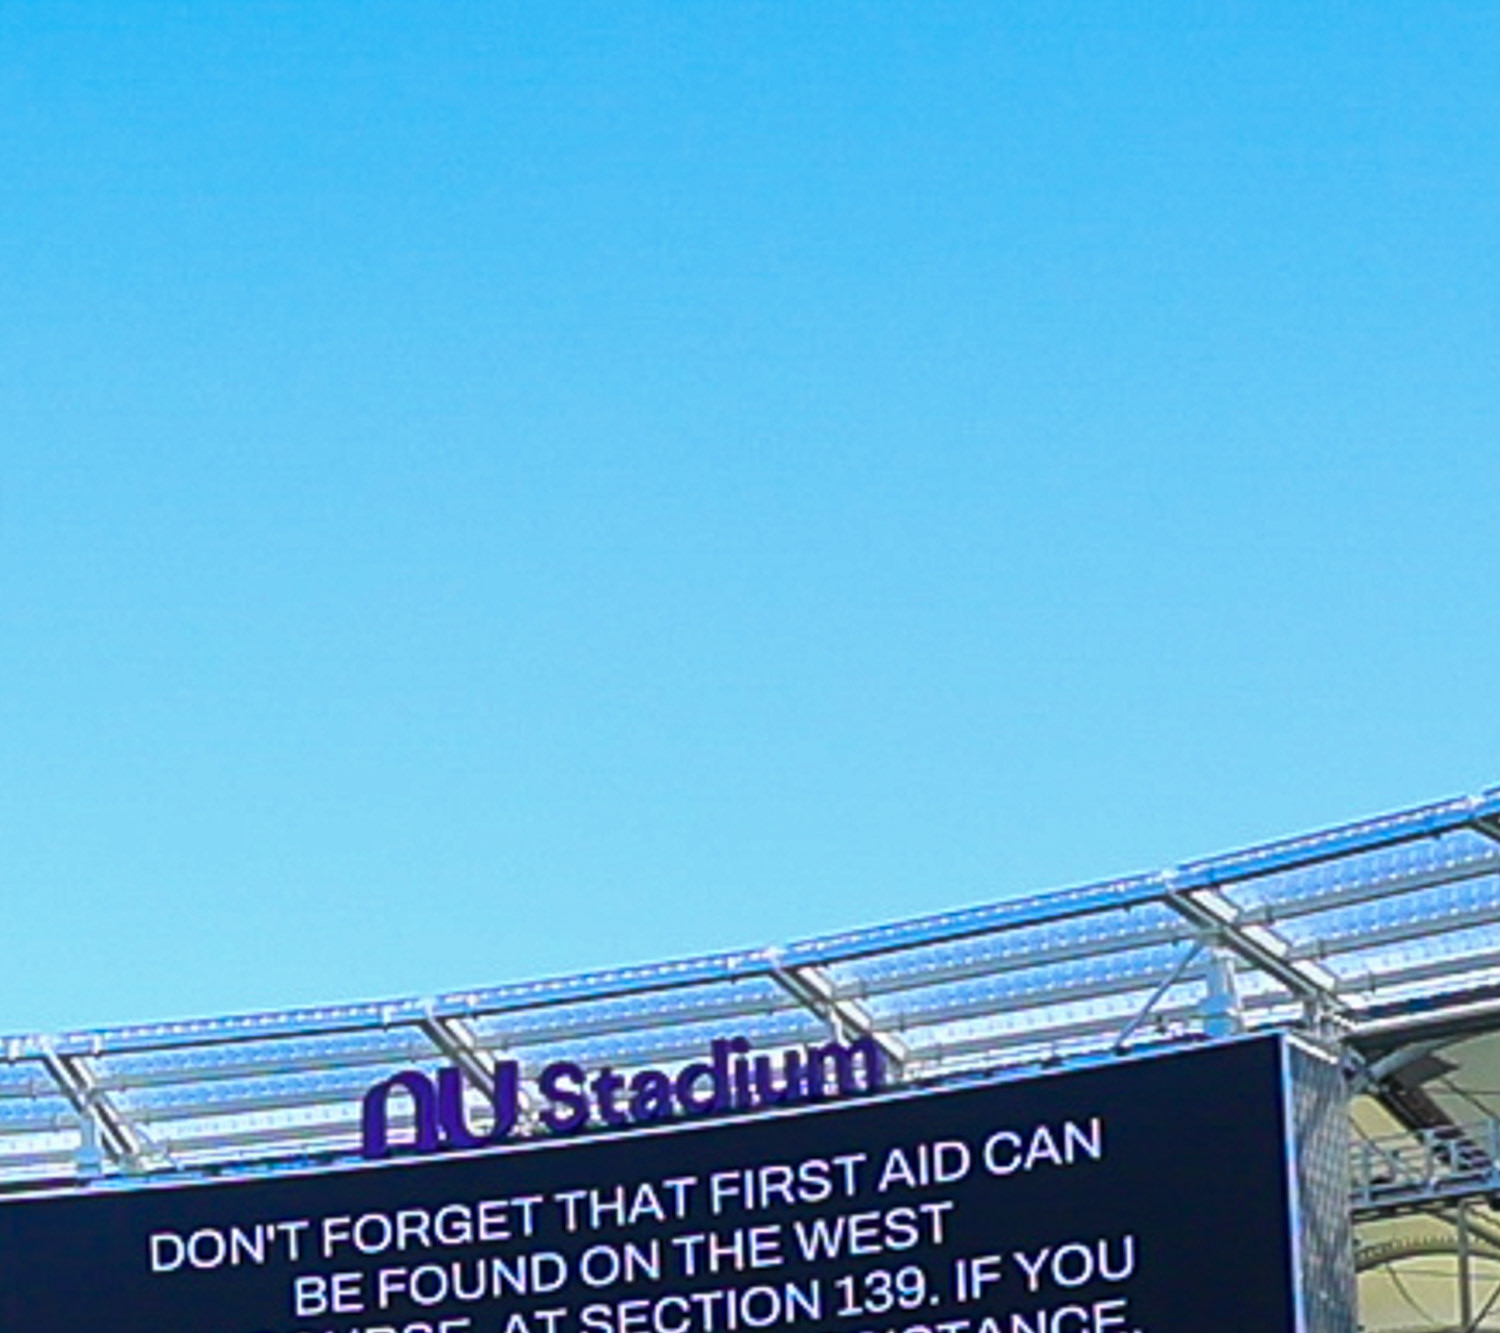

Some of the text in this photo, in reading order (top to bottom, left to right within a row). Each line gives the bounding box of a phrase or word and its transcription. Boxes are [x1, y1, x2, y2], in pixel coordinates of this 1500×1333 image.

[537, 1036, 885, 1134] Stadium
[151, 1118, 1100, 1271] DON'T FORGET THAT FIRST AID CAN
[295, 1201, 952, 1316] BE FOUND ON THE WEST
[837, 1266, 938, 1316] 139.
[957, 1256, 1000, 1301] IF
[1014, 1236, 1133, 1291] YOU
